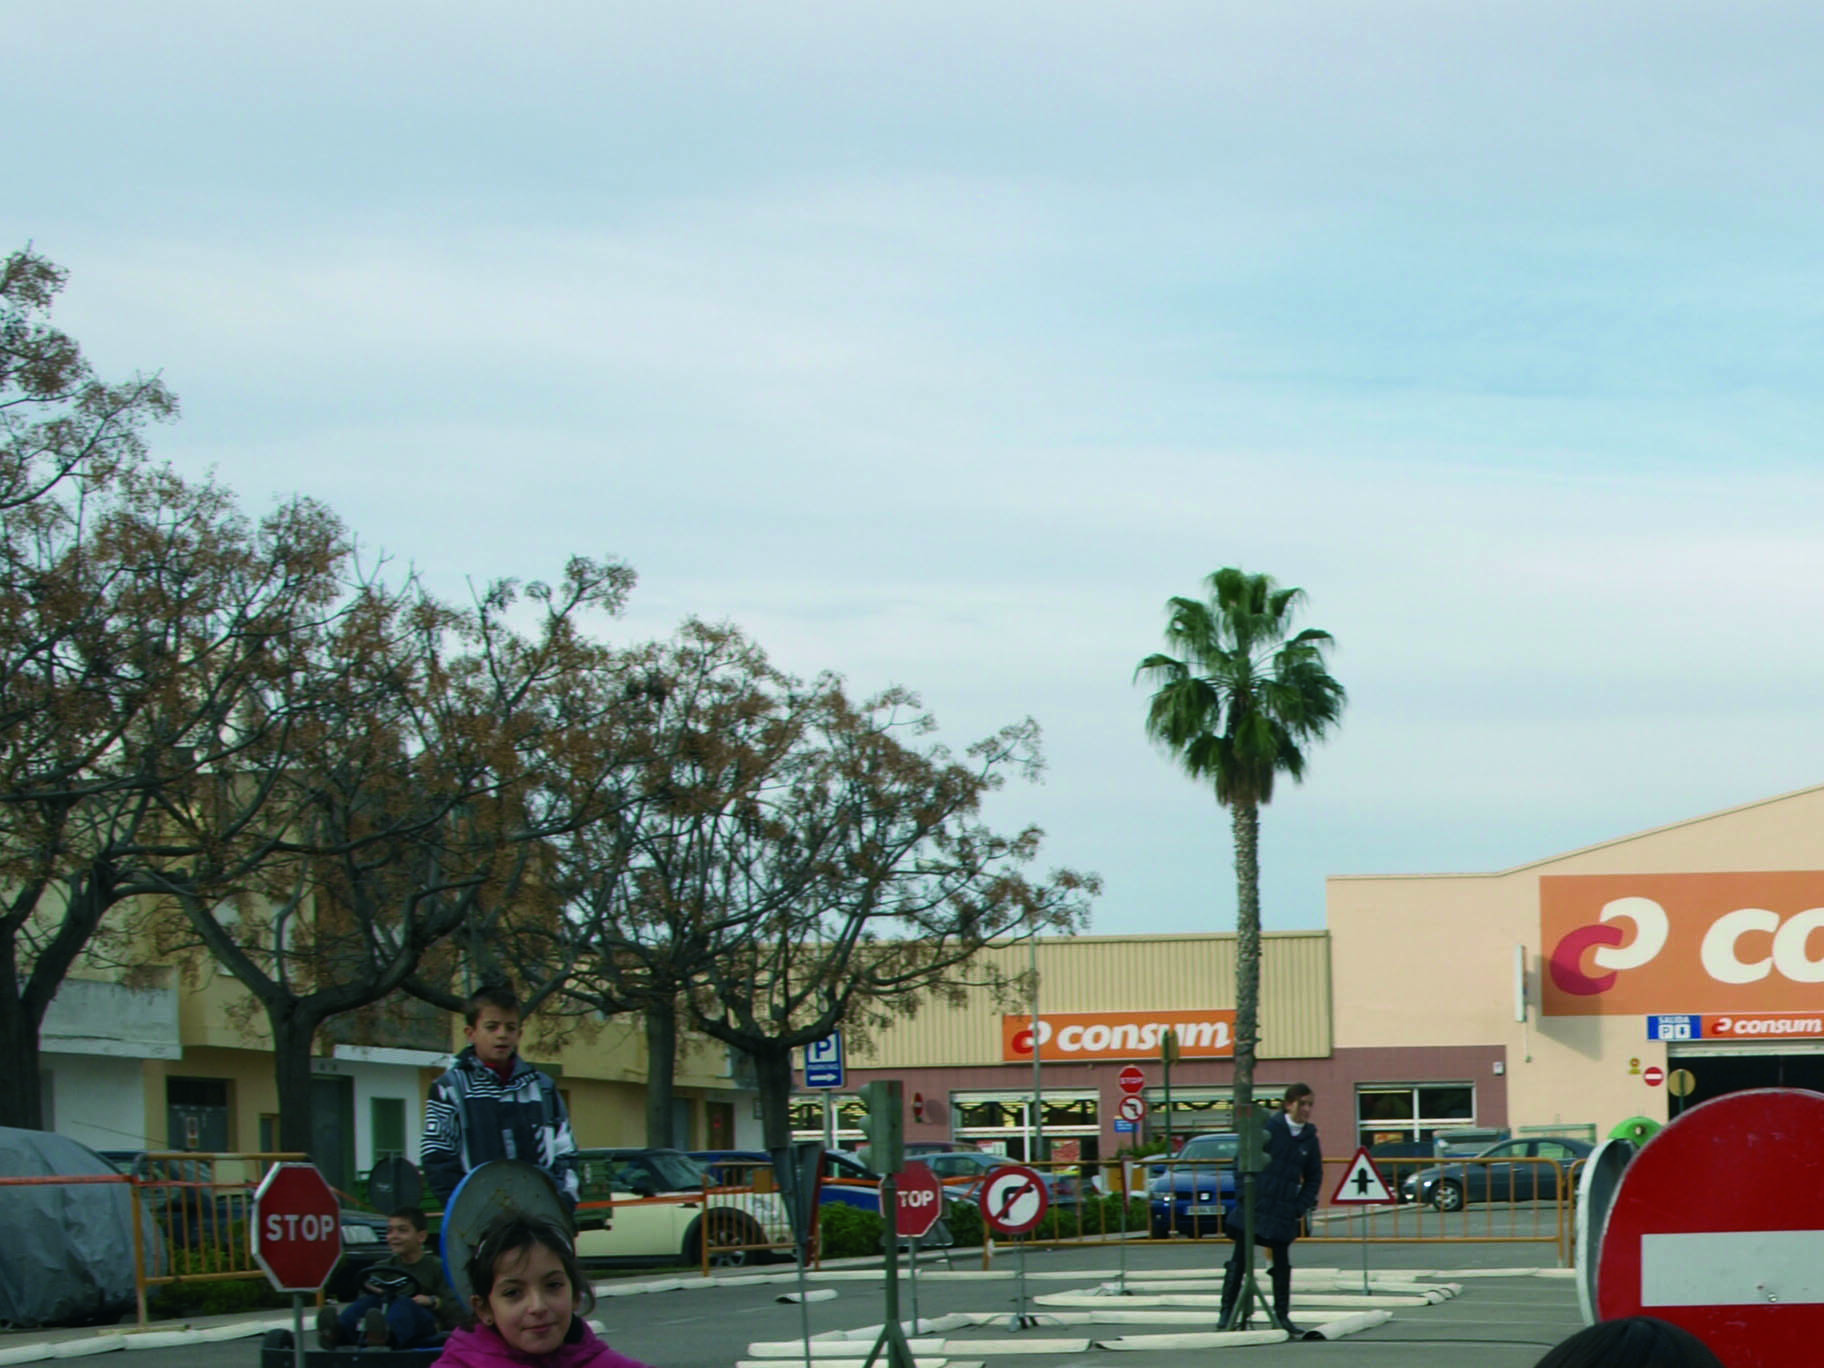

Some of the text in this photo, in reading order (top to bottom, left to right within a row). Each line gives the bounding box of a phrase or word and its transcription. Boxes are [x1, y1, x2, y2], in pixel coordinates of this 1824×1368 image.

[1733, 1018, 1823, 1035] consum
[896, 1189, 935, 1208] TOP
[265, 1213, 335, 1242] STOP
